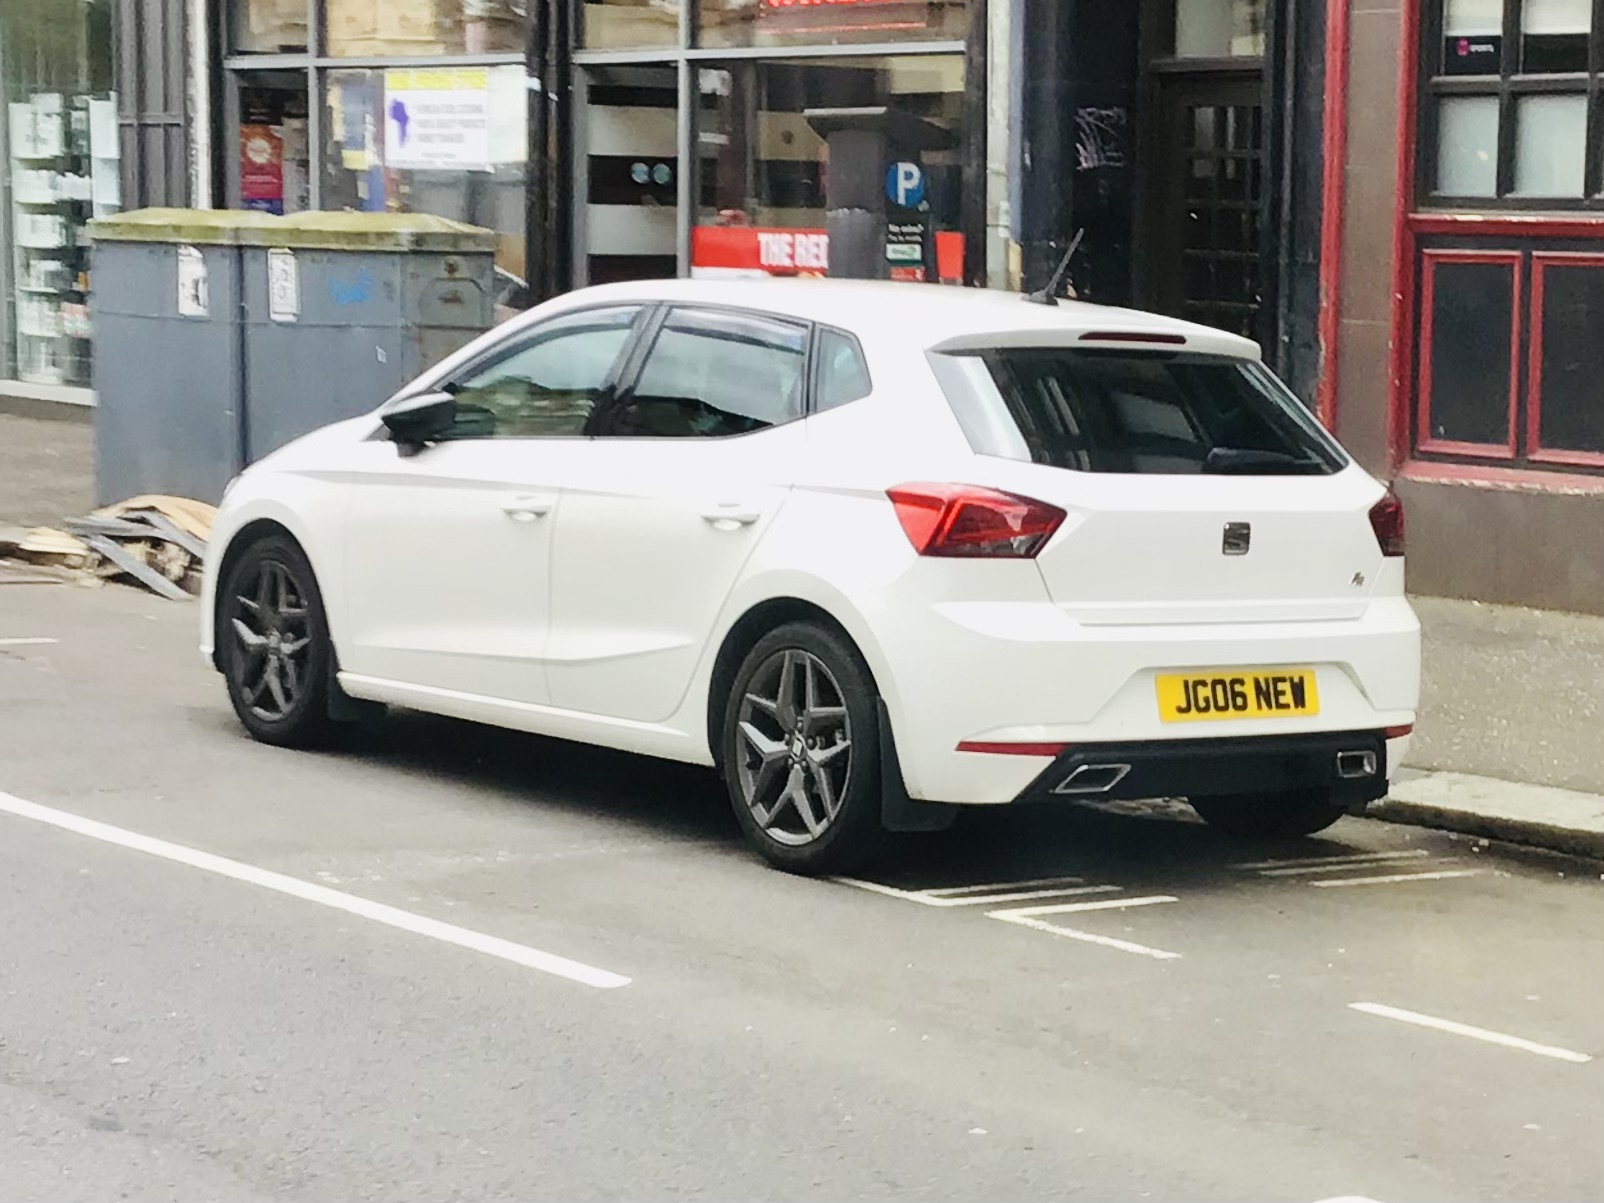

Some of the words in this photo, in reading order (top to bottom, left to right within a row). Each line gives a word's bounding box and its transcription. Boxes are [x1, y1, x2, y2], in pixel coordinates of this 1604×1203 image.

[897, 162, 921, 206] P
[757, 232, 793, 267] THE
[1176, 678, 1248, 714] JG06
[1253, 676, 1306, 711] NEW
